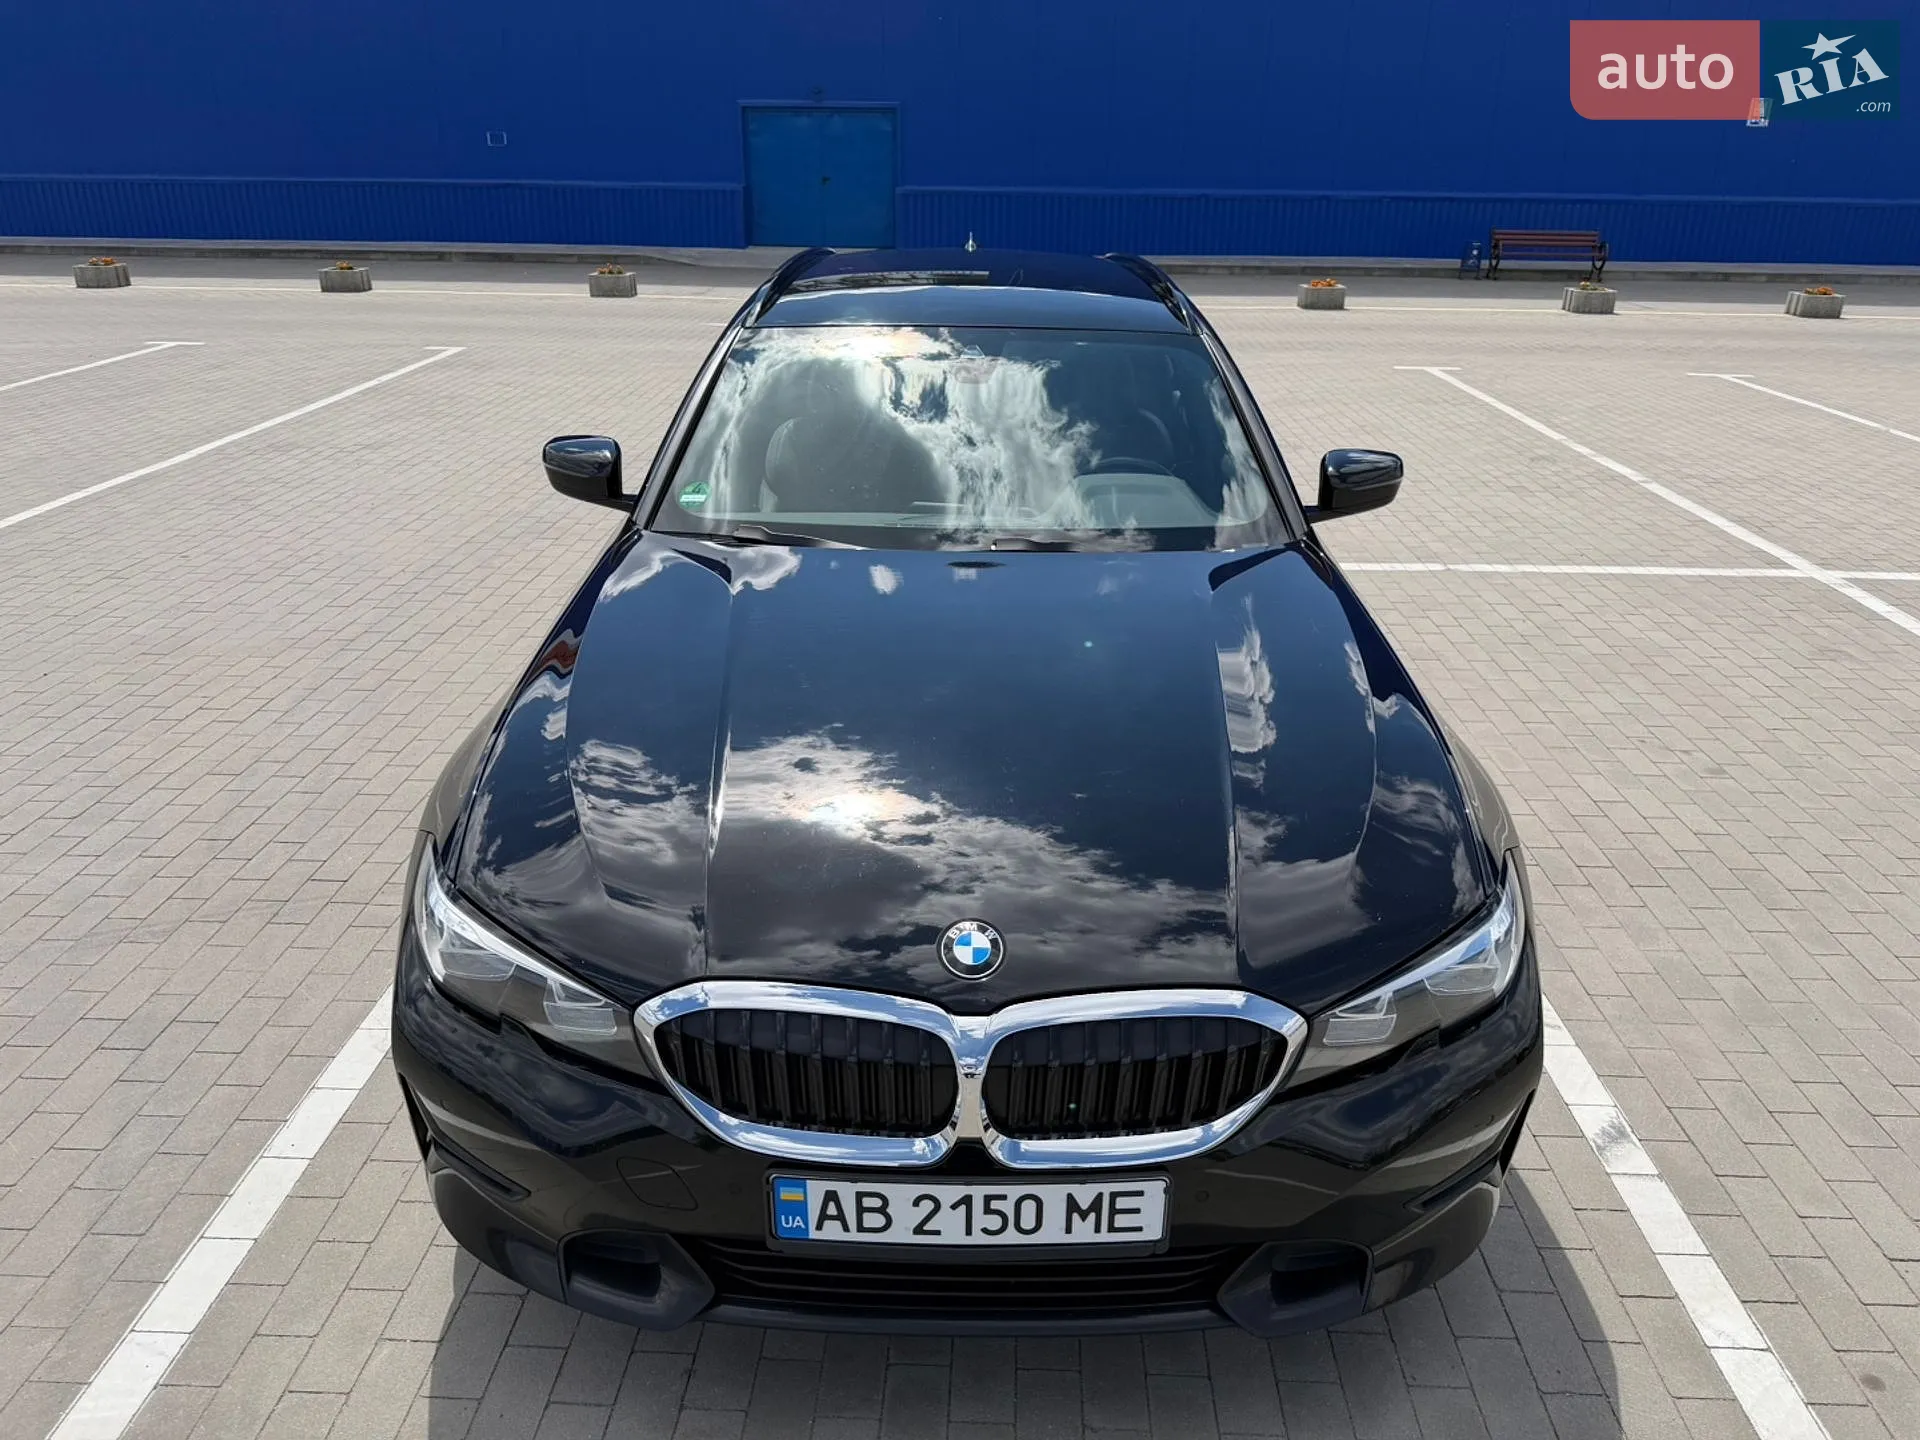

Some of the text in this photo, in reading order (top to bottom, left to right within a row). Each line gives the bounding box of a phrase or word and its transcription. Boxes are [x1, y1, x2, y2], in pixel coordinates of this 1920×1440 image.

[947, 921, 999, 940] BMW
[781, 1214, 806, 1230] UA
[814, 1189, 1146, 1237] AB 2150 ME
